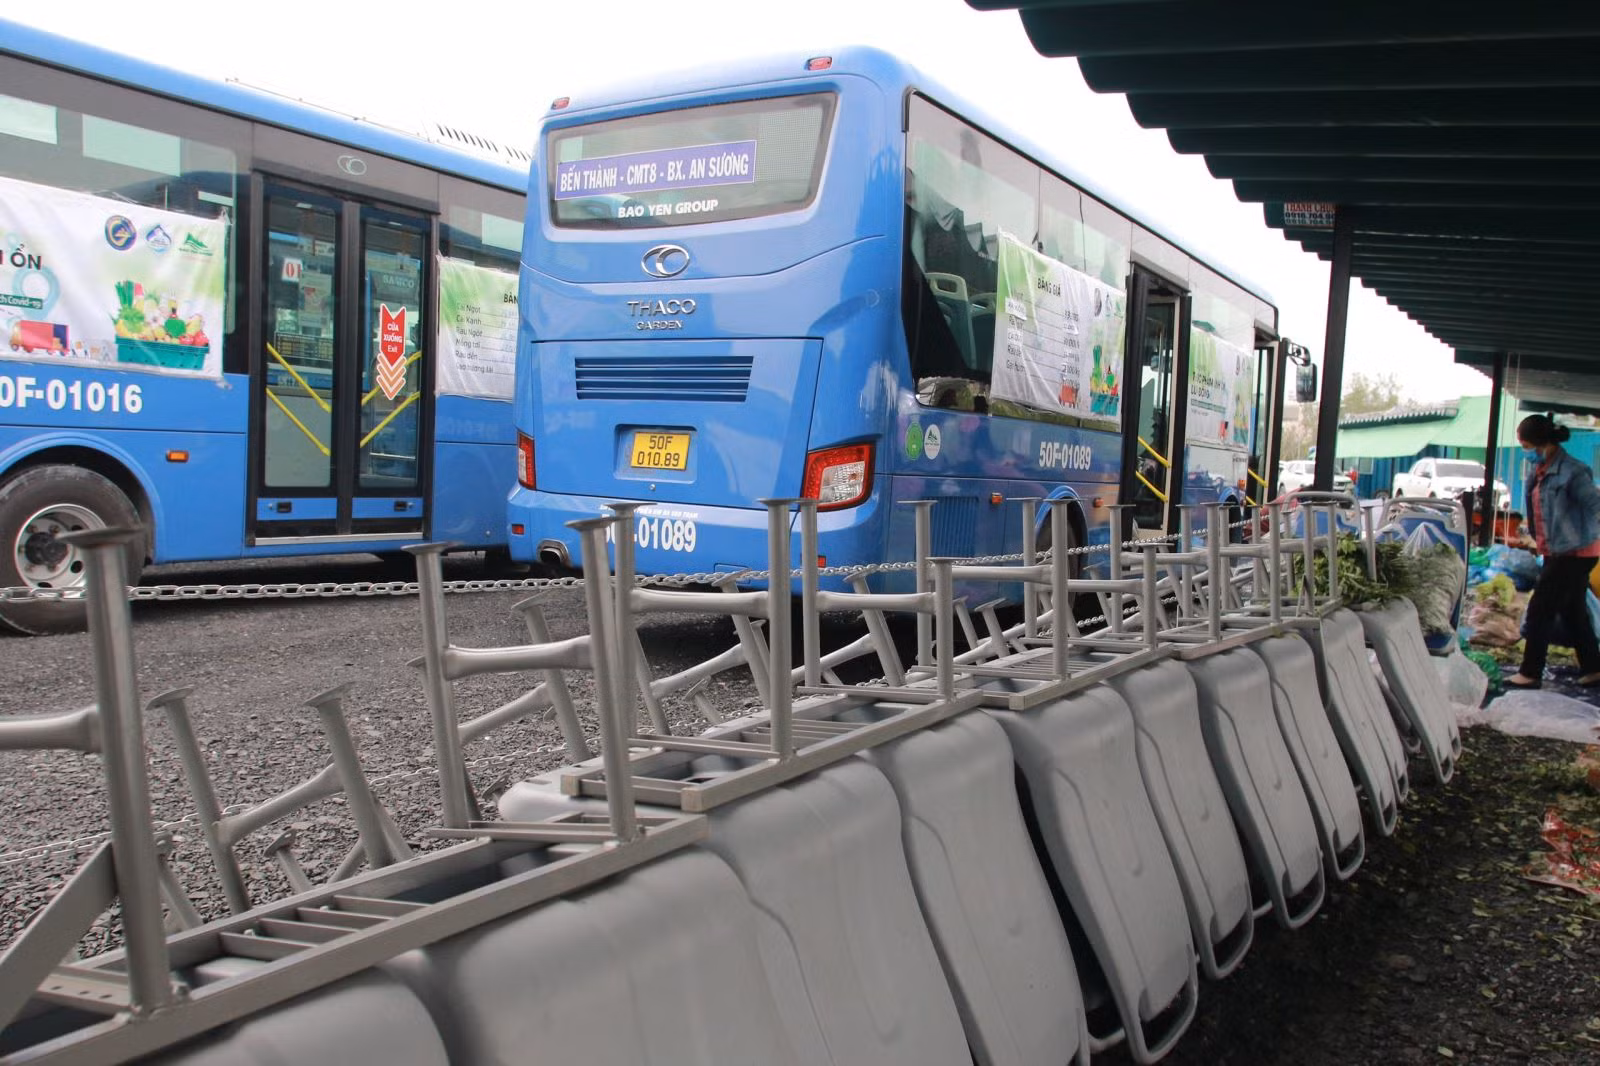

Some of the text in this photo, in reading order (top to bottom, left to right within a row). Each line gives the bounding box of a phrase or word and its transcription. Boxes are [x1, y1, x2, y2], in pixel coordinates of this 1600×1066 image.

[560, 164, 580, 192] BẾN
[583, 164, 618, 190] THÀNH
[626, 163, 657, 186] CMT8
[667, 160, 686, 181] BX.
[689, 158, 706, 179] AN
[708, 152, 749, 178] SƯƠNG
[617, 199, 719, 218] BAO YEN GROUP
[10, 243, 42, 270] ỔN
[8, 296, 41, 309] Covid-19
[627, 298, 697, 317] THACO
[636, 320, 683, 331] GARDEN
[649, 435, 673, 450] 50F
[637, 451, 680, 467] 010.89
[1038, 441, 1092, 471] 50F-01089
